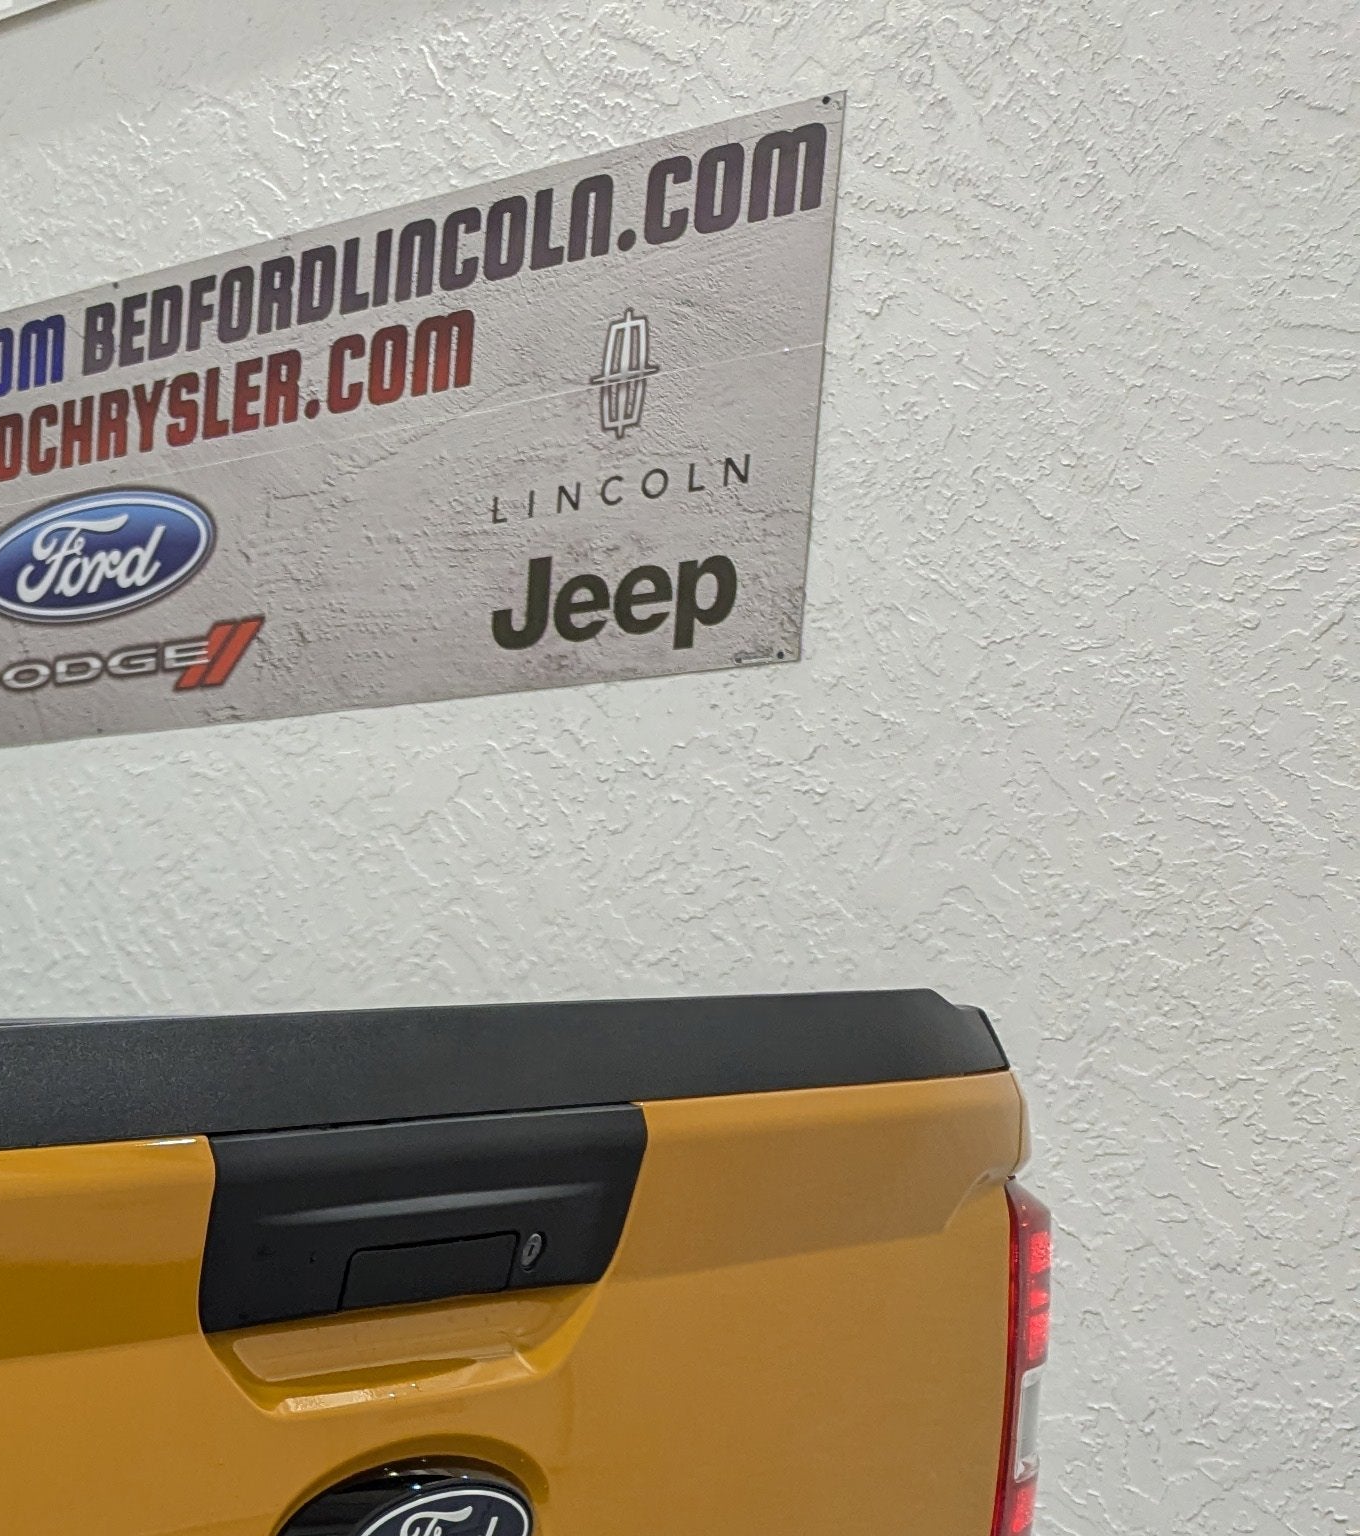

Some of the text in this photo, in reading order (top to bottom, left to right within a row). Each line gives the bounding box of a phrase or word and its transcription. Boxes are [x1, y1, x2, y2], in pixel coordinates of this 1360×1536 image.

[80, 121, 827, 377] BEDFORDLINCOLN.COM
[492, 453, 753, 524] LINCOLN
[16, 513, 166, 603] Ford
[491, 555, 738, 650] Jeep
